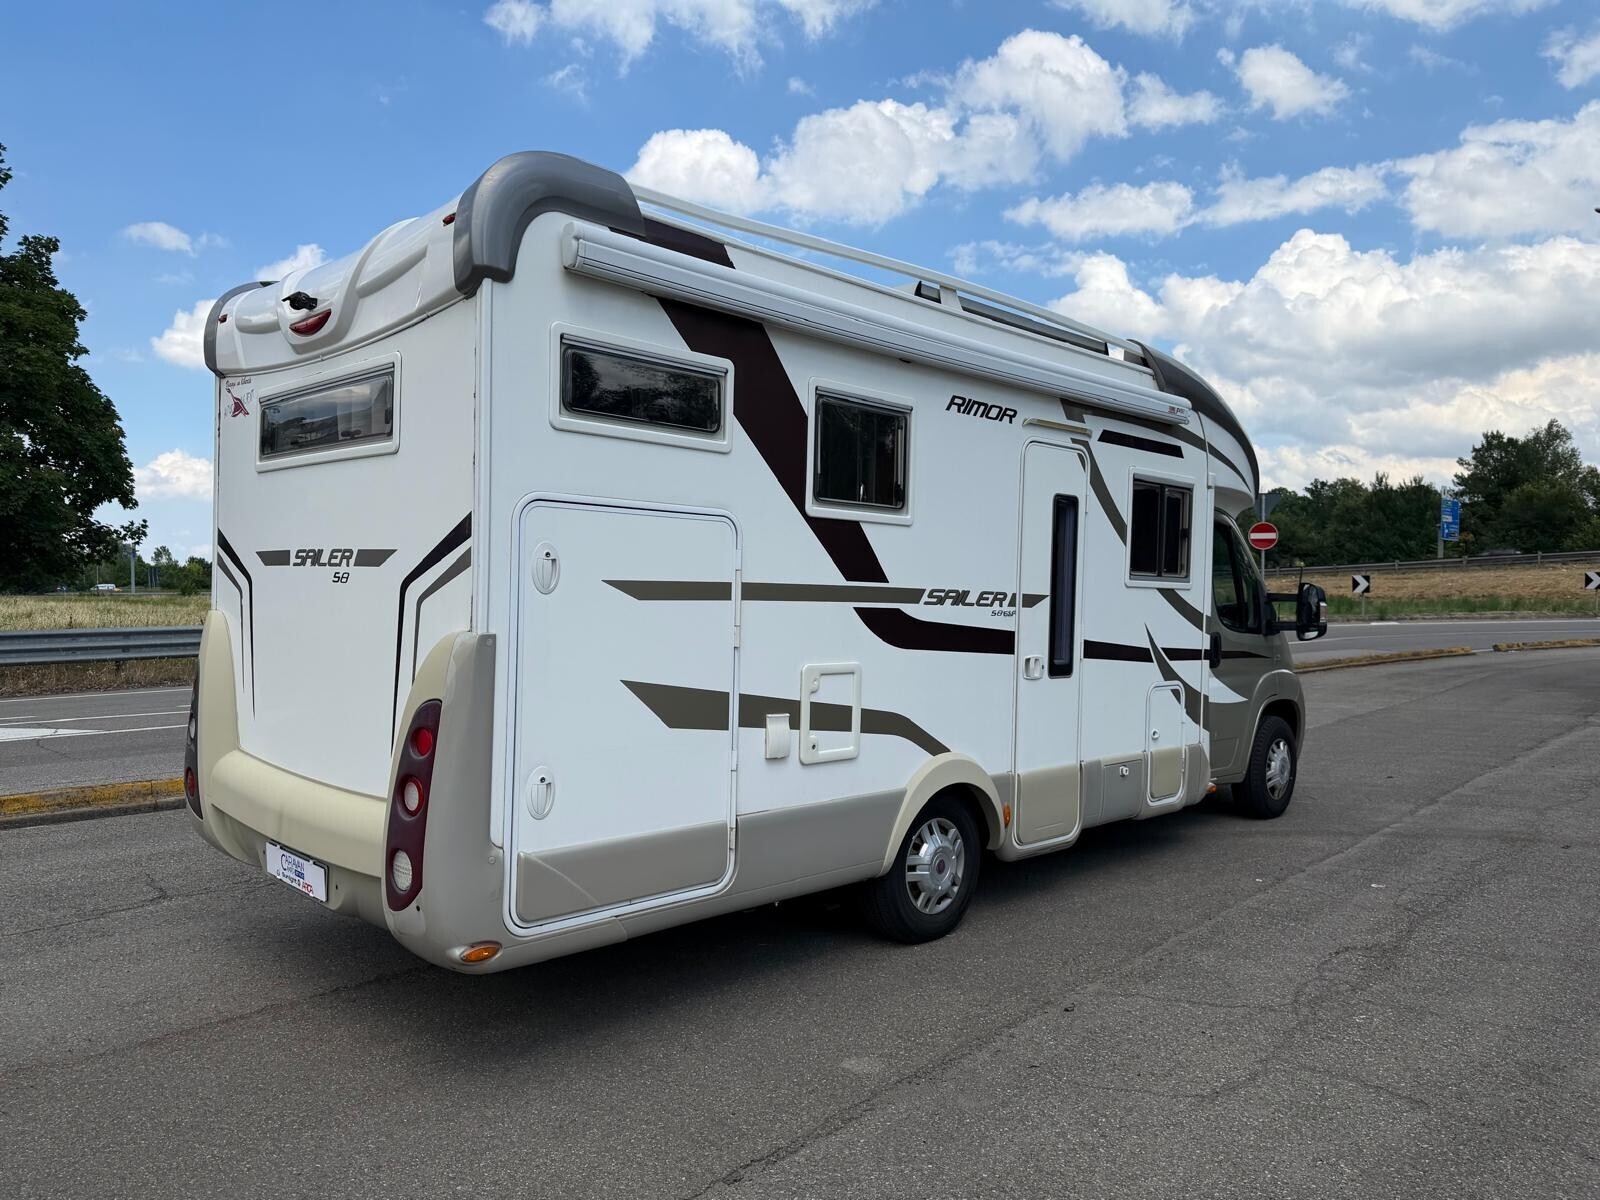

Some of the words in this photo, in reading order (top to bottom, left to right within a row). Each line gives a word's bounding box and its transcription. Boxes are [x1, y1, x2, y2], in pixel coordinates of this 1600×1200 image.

[945, 395, 1018, 424] RIMOR
[293, 548, 354, 567] SAILER
[923, 588, 1008, 608] SAILER
